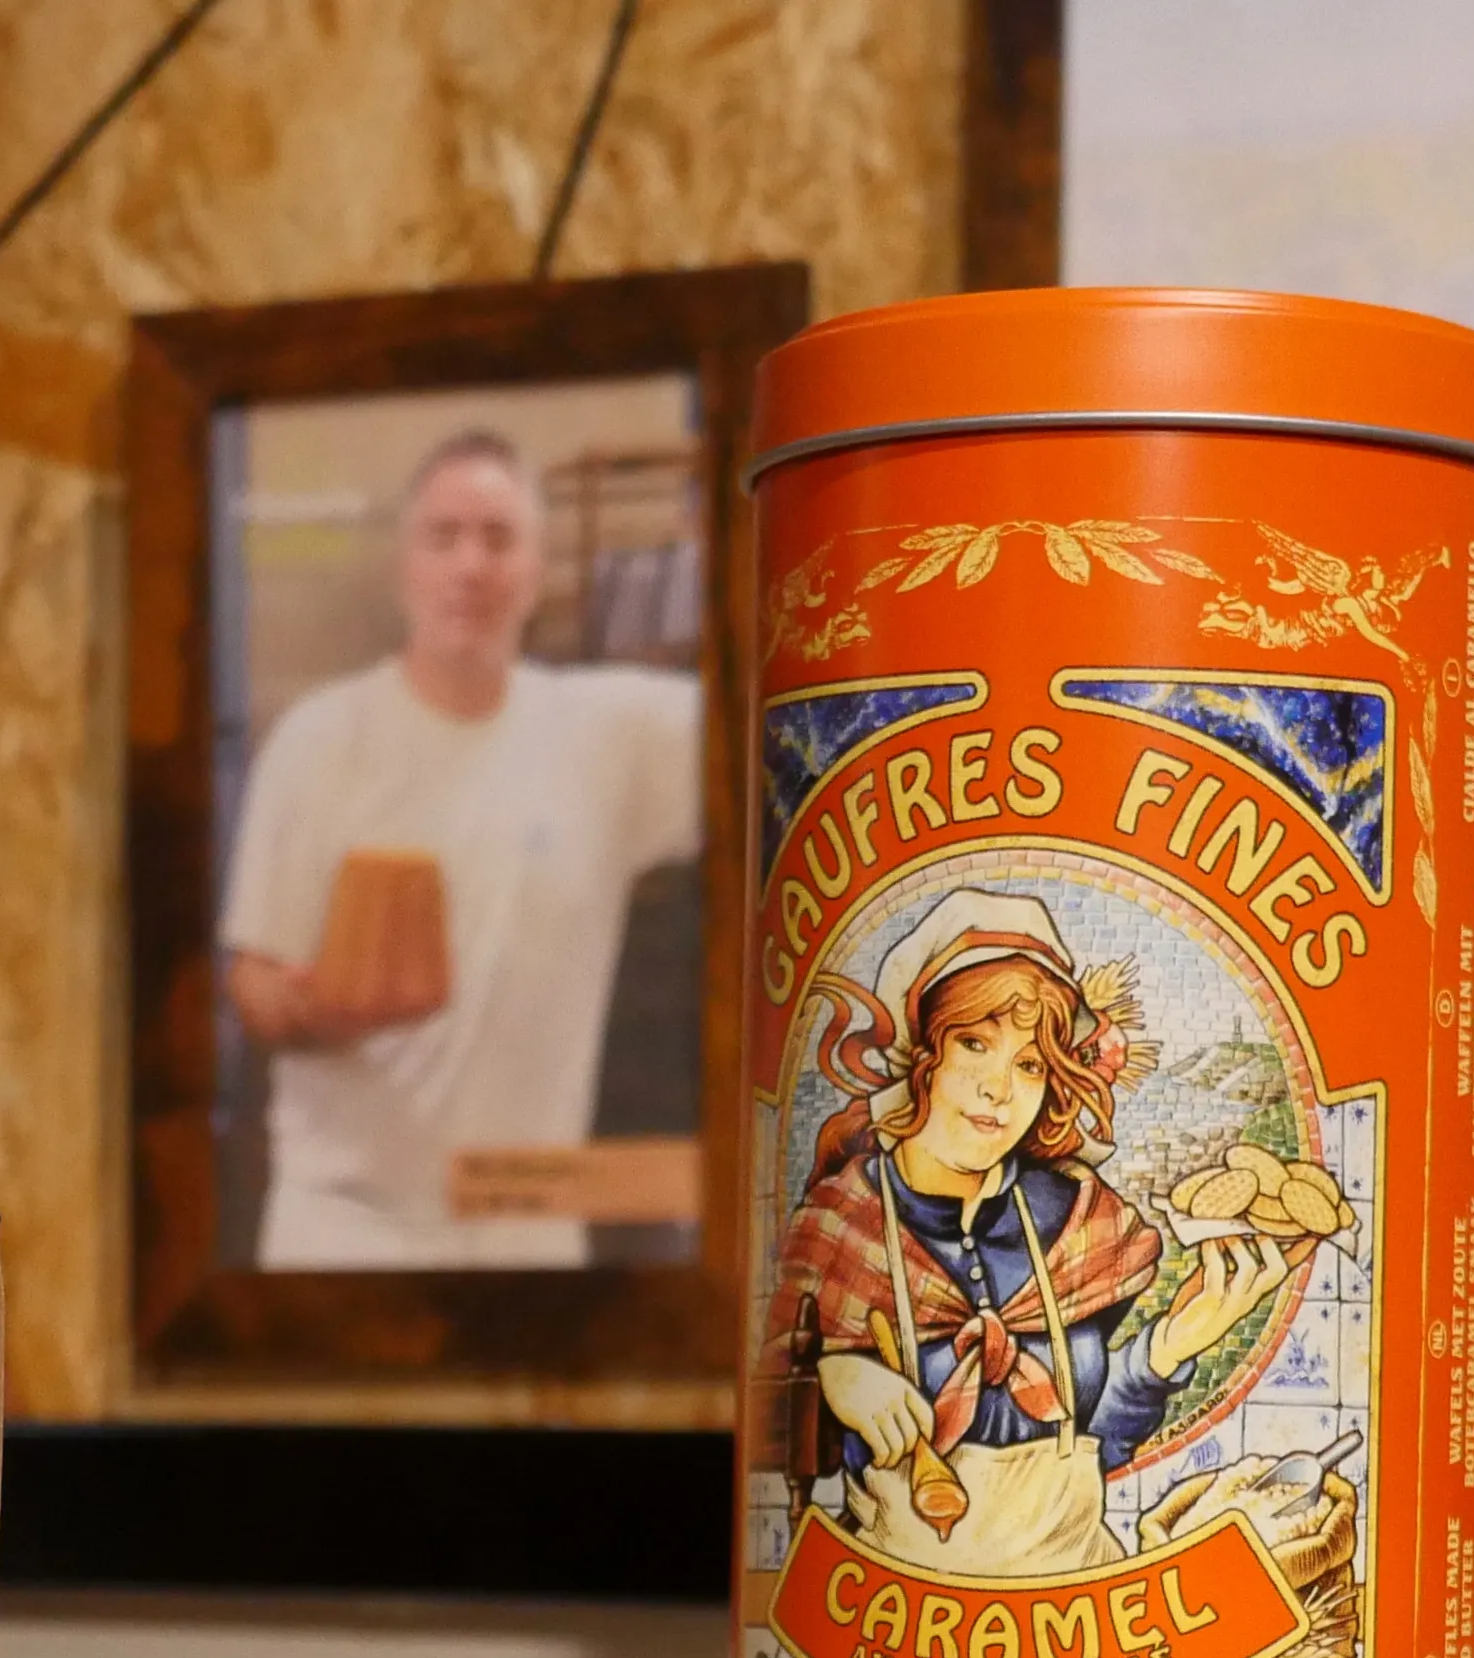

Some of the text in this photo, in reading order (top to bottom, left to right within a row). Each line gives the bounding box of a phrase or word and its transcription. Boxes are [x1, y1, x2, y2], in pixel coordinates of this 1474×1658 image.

[763, 727, 1368, 1006] GAUFRES FINES
[1457, 924, 1473, 1097] WAFFELN MIT
[1449, 1217, 1468, 1464] WAFELS MET ZOUTE
[1445, 1517, 1461, 1589] MADE
[1459, 1540, 1474, 1636] BUTTER
